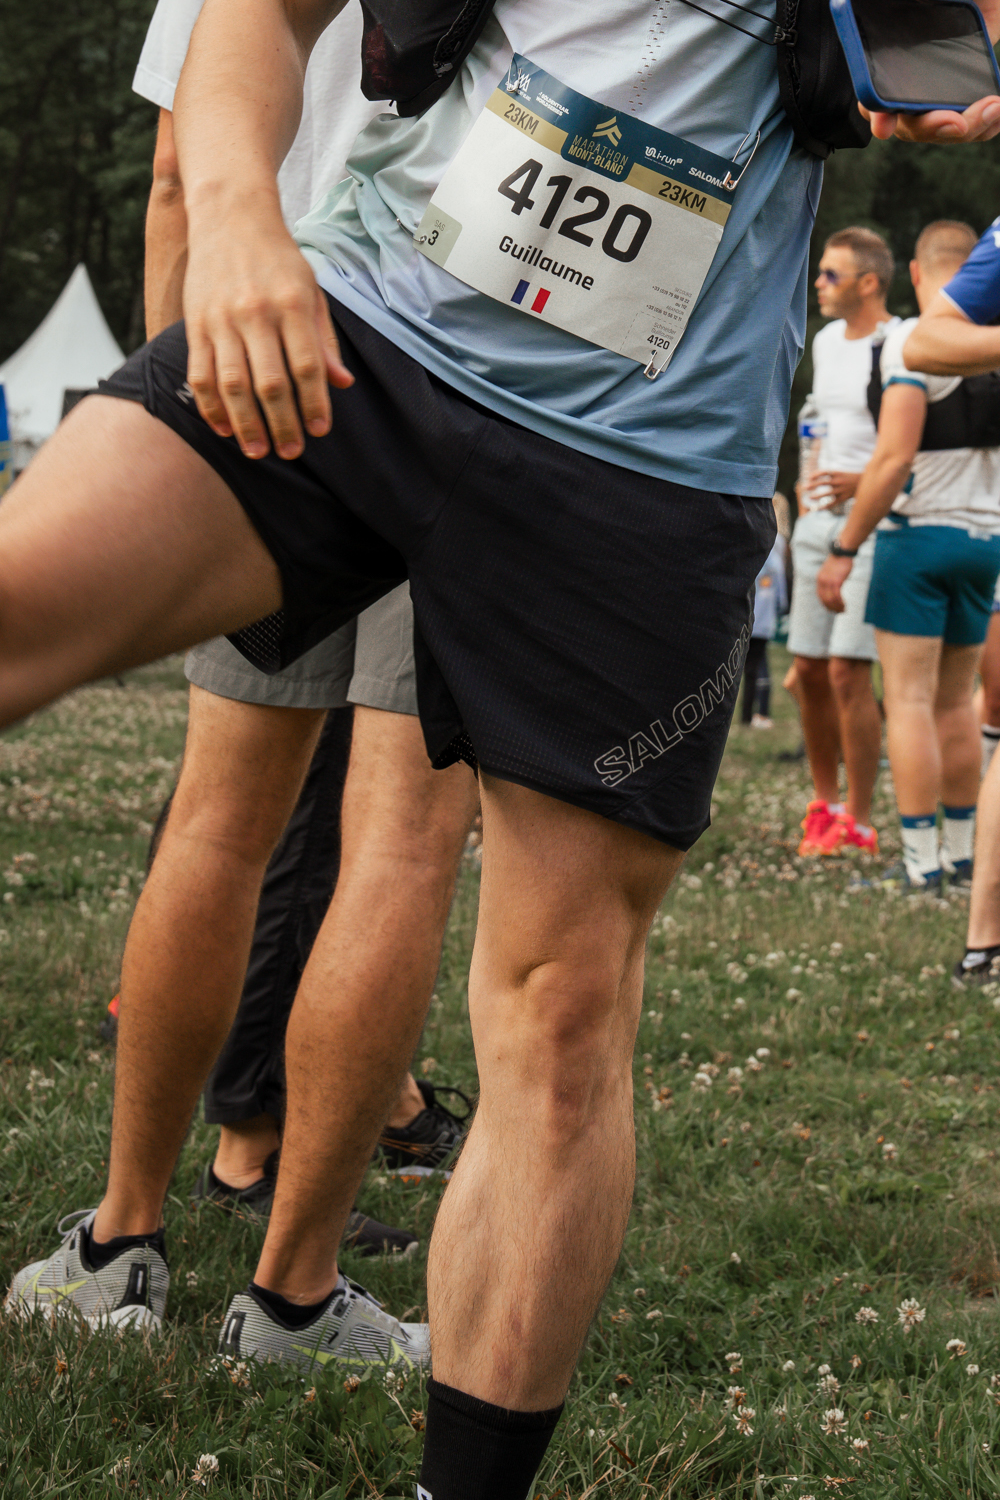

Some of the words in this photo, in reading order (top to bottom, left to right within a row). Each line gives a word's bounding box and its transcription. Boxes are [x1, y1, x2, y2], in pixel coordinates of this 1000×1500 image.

[503, 102, 540, 135] 23KM
[568, 144, 624, 175] MONT-BLANC
[572, 134, 629, 166] MARATHON
[497, 158, 653, 263] 4120
[658, 180, 707, 213] 23KM
[427, 229, 439, 246] 3
[434, 219, 446, 232] SAS
[498, 235, 595, 291] Guillaume
[647, 334, 670, 350] 4120
